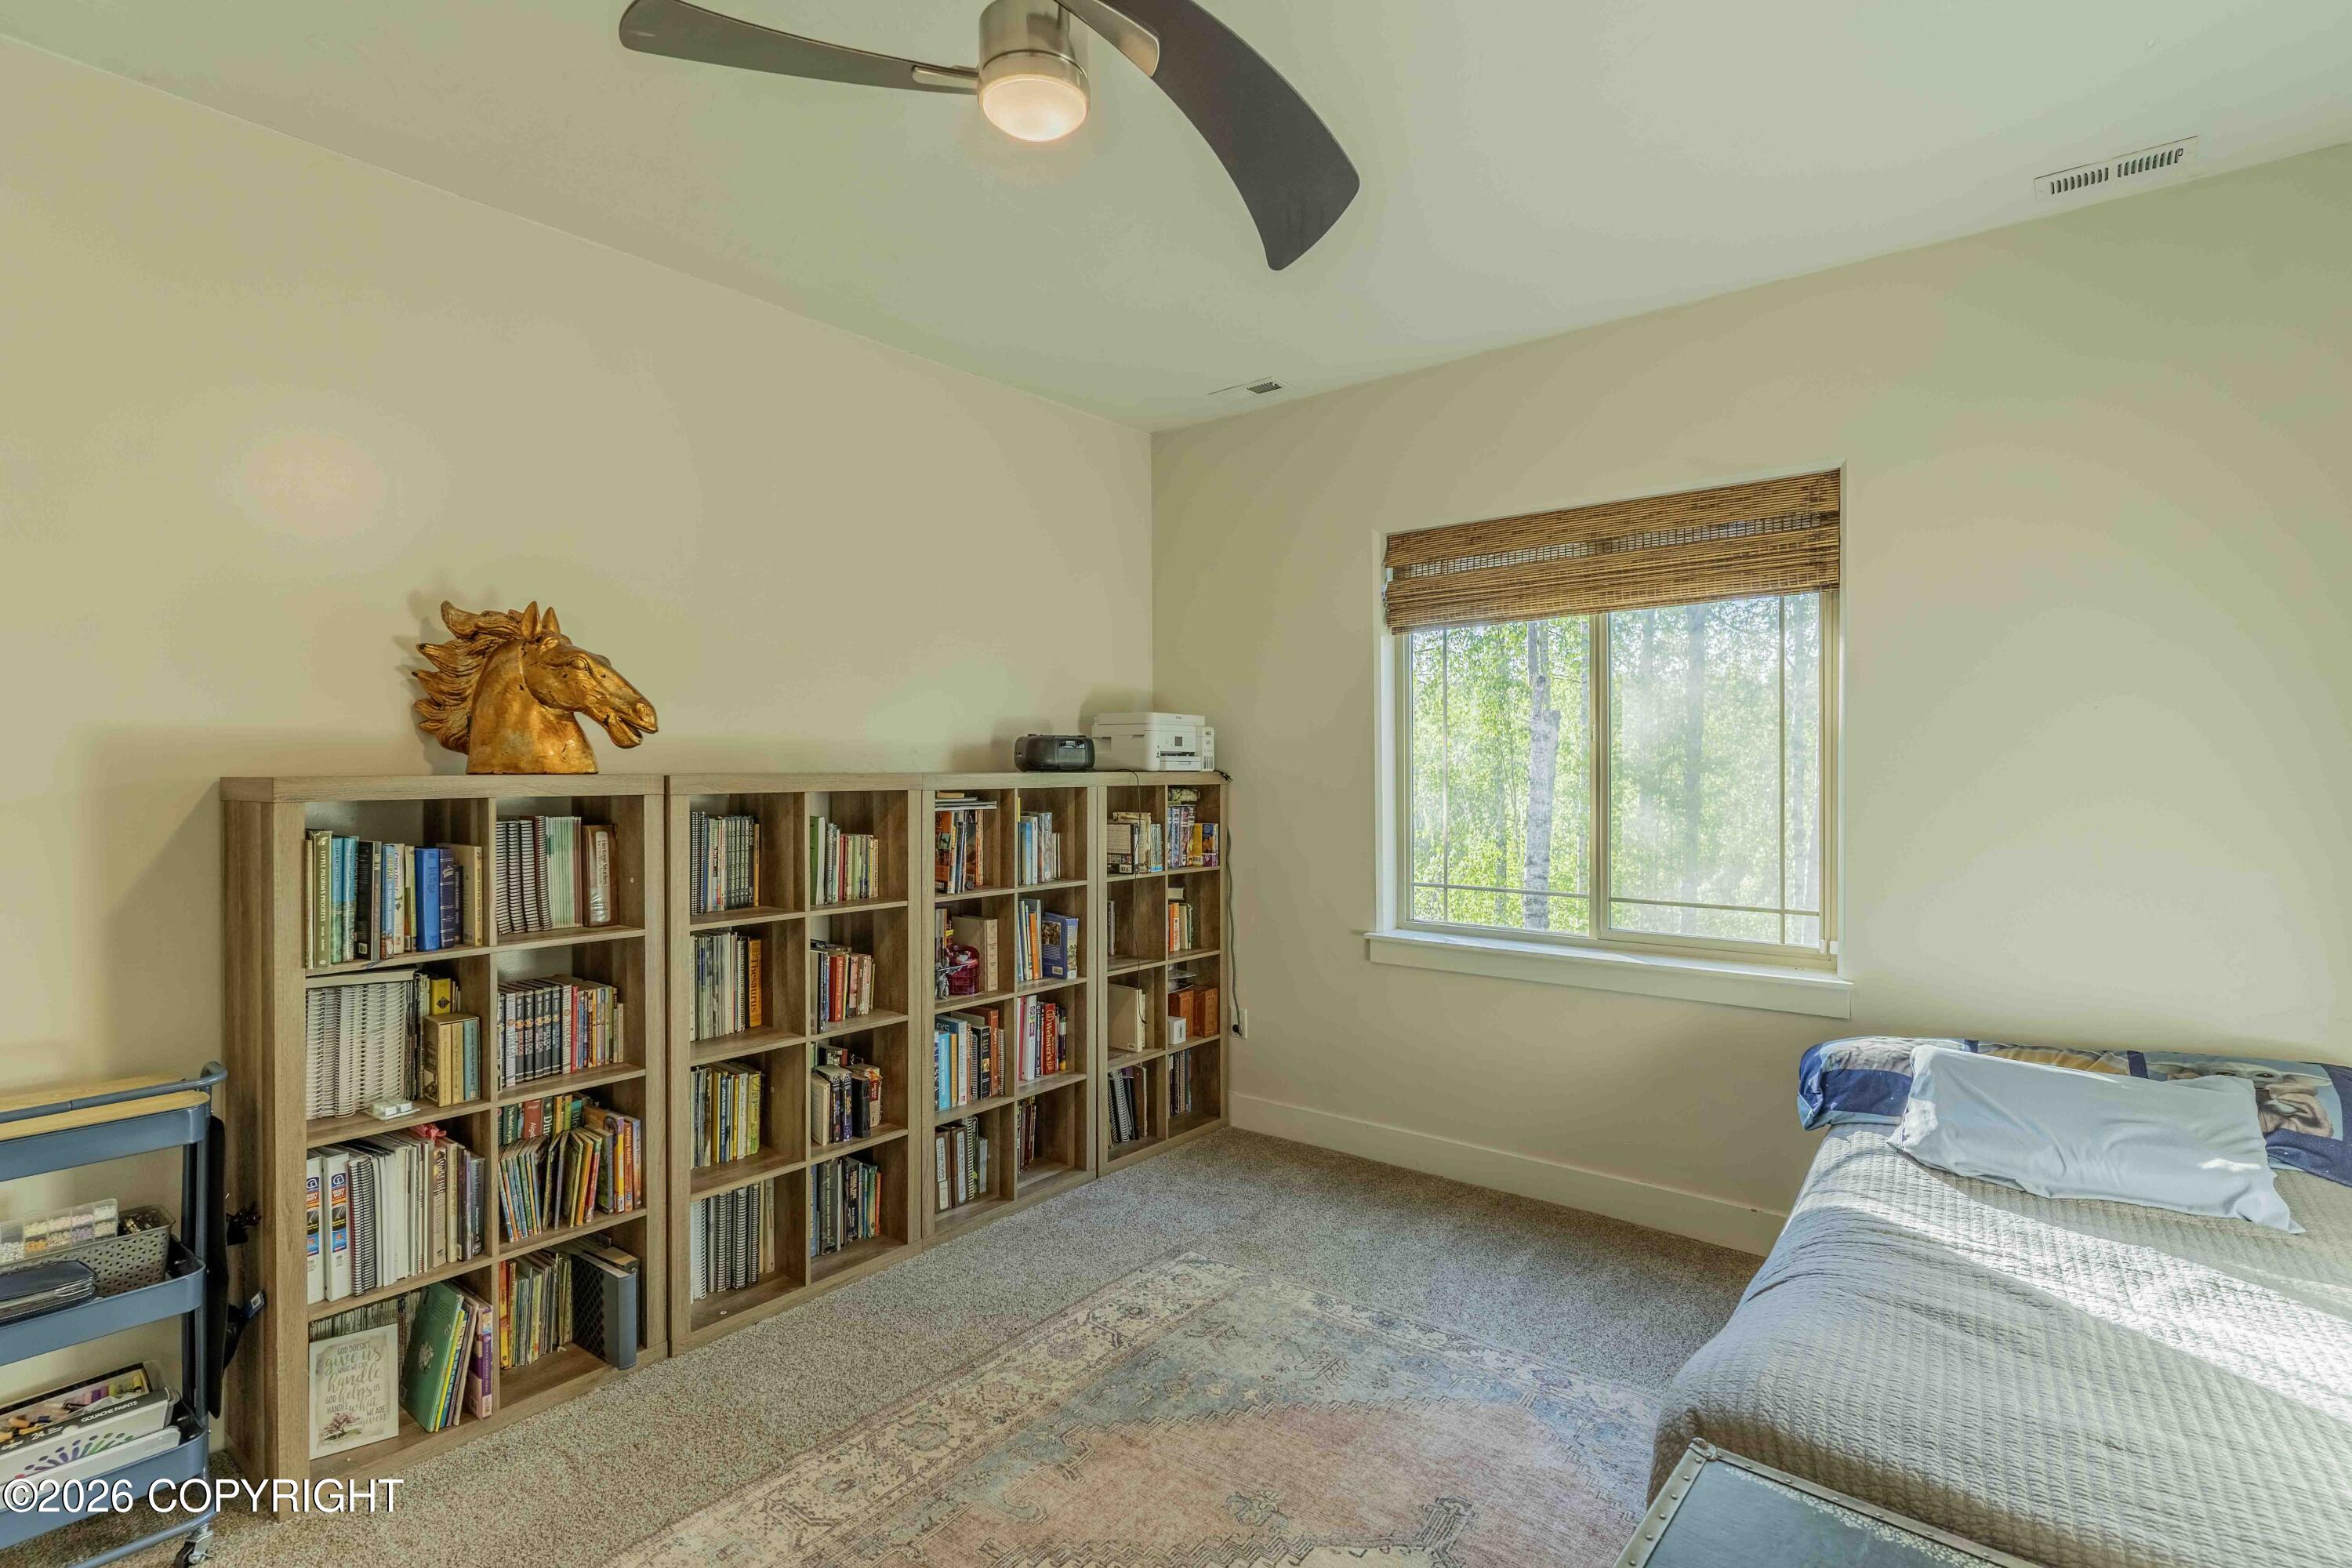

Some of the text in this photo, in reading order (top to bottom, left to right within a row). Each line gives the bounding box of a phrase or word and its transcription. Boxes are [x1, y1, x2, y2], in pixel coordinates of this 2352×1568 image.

[750, 956, 759, 1013] Thesaurus
[436, 1158, 445, 1178] World
[337, 1341, 371, 1356] GOD DOESN'T
[325, 1347, 382, 1376] give us
[325, 1383, 381, 1406] GOD helps US
[327, 1404, 349, 1415] HANDLE
[376, 1406, 386, 1414] ARE
[31, 1430, 45, 1441] 24
[81, 1408, 114, 1422] GOUACHE
[114, 1400, 138, 1412] PAINTS
